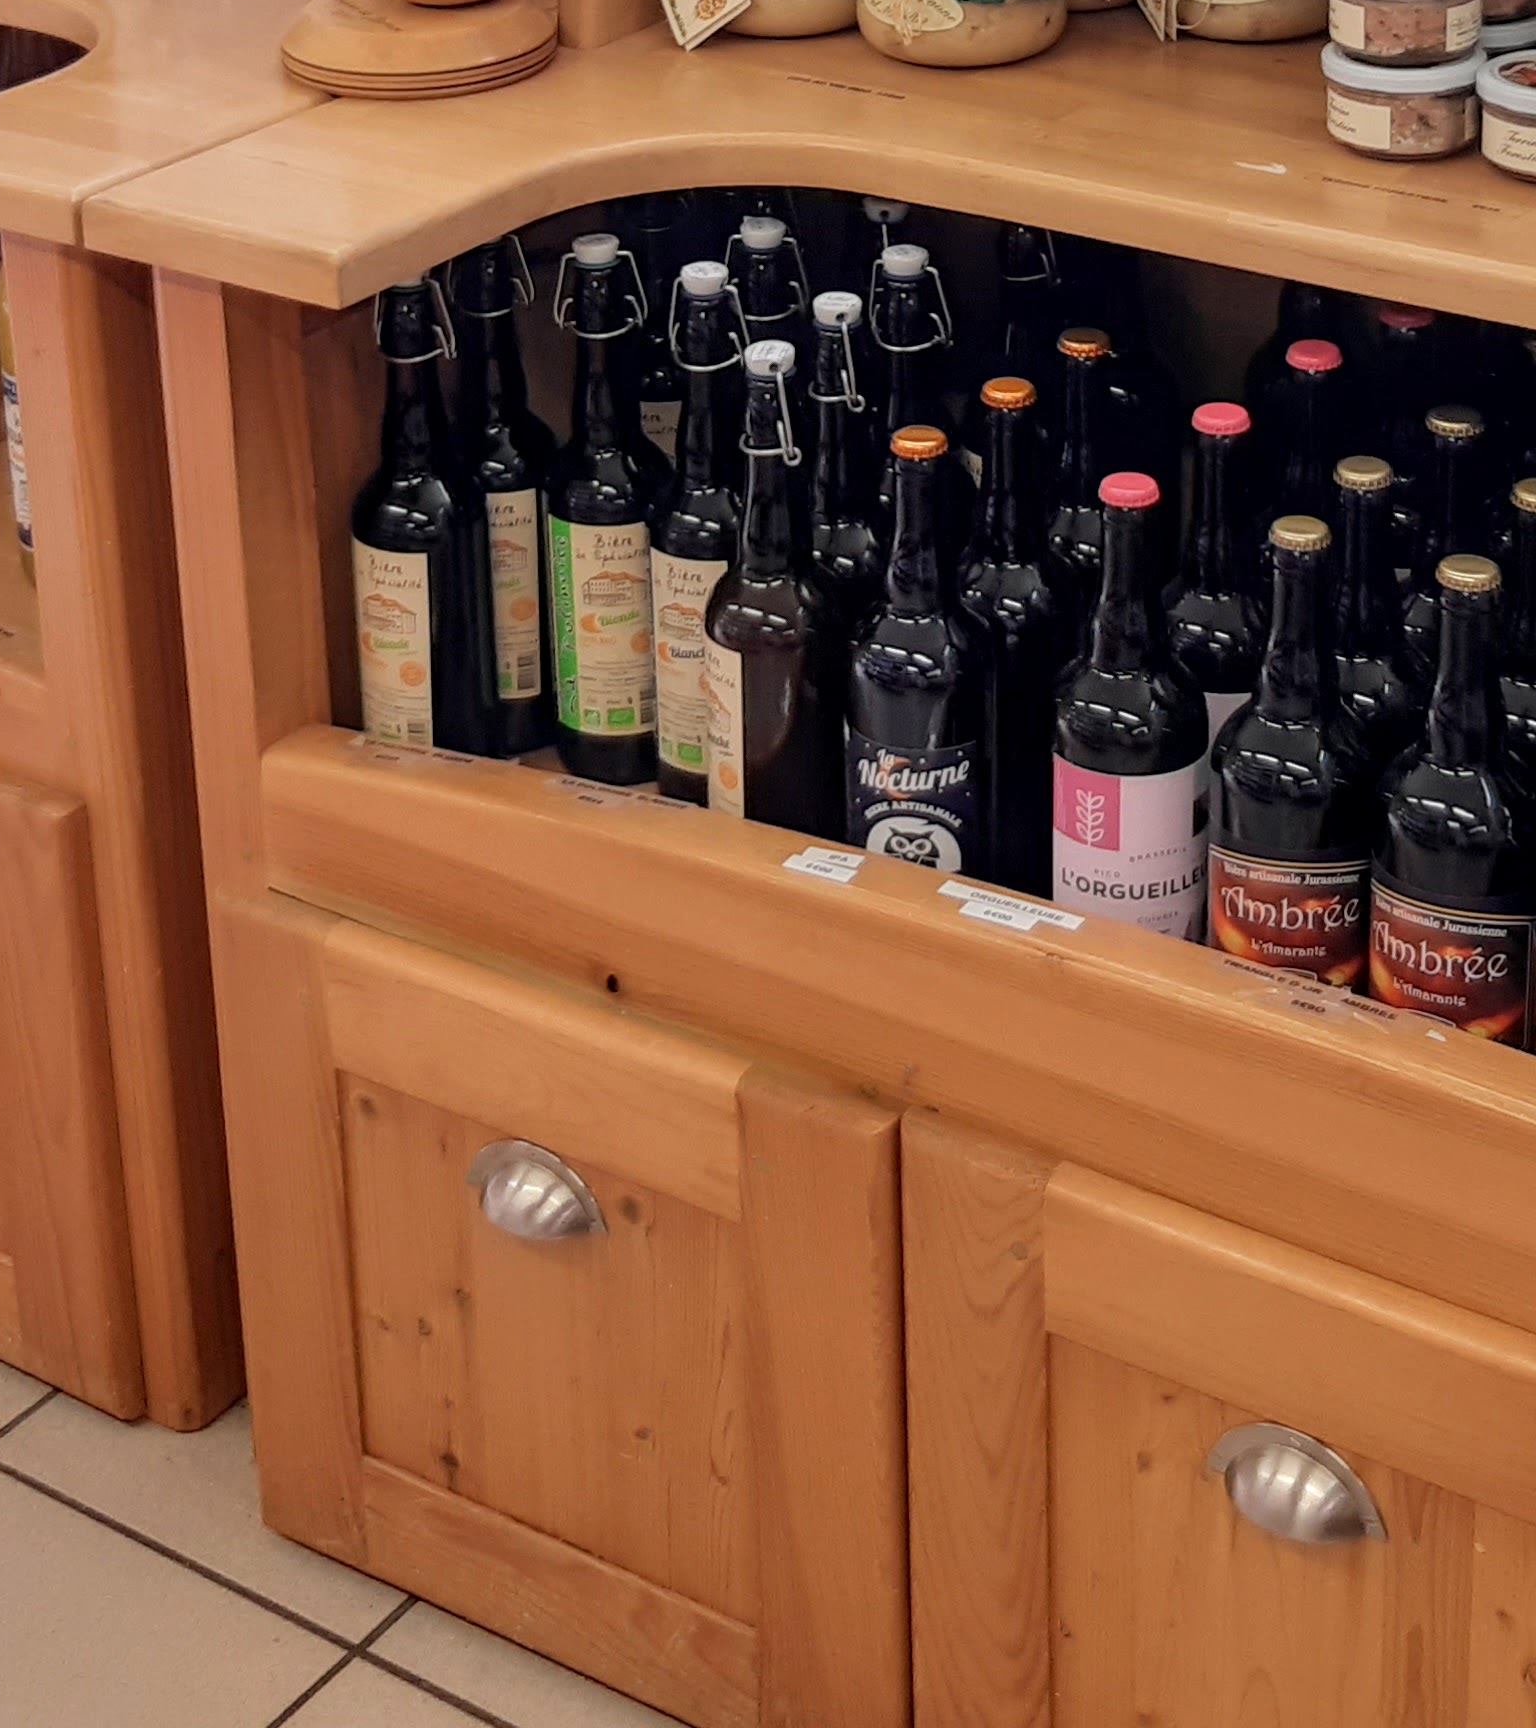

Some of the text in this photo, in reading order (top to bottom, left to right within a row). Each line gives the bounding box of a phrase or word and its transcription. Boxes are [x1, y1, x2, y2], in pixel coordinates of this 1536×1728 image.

[593, 533, 633, 549] Bière
[666, 565, 704, 582] Bière
[858, 756, 970, 795] Nocturne
[890, 800, 964, 830] ARTISANALE
[1129, 847, 1187, 863] BRASSERIE
[1248, 868, 1302, 886] artisanale
[1303, 870, 1360, 886] Jurassienne
[969, 890, 1066, 923] ORGUEILLEUSE
[1220, 885, 1360, 932] Ambrée
[1394, 902, 1508, 939] artisanale Jurassienne
[1372, 920, 1509, 982] Ambrée
[1224, 958, 1286, 984] TRIANGLE
[1341, 997, 1399, 1020] AMBREE
